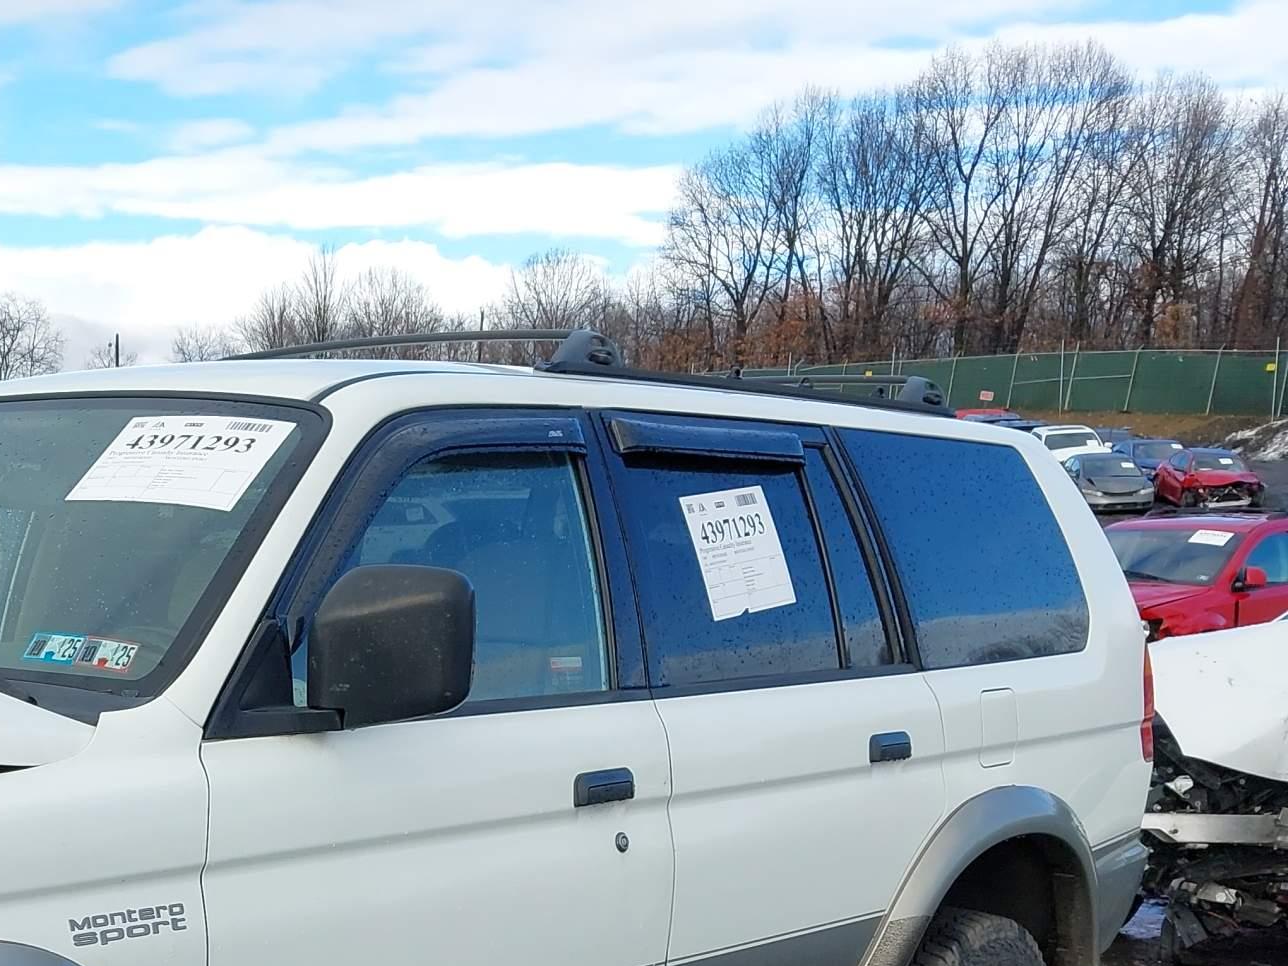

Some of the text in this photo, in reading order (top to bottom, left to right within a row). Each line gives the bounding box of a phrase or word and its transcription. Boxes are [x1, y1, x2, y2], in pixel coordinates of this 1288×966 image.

[126, 433, 256, 453] 43971293
[701, 513, 765, 544] 43971293
[62, 639, 81, 658] 25
[115, 646, 135, 667] 25
[69, 903, 184, 931] Montero
